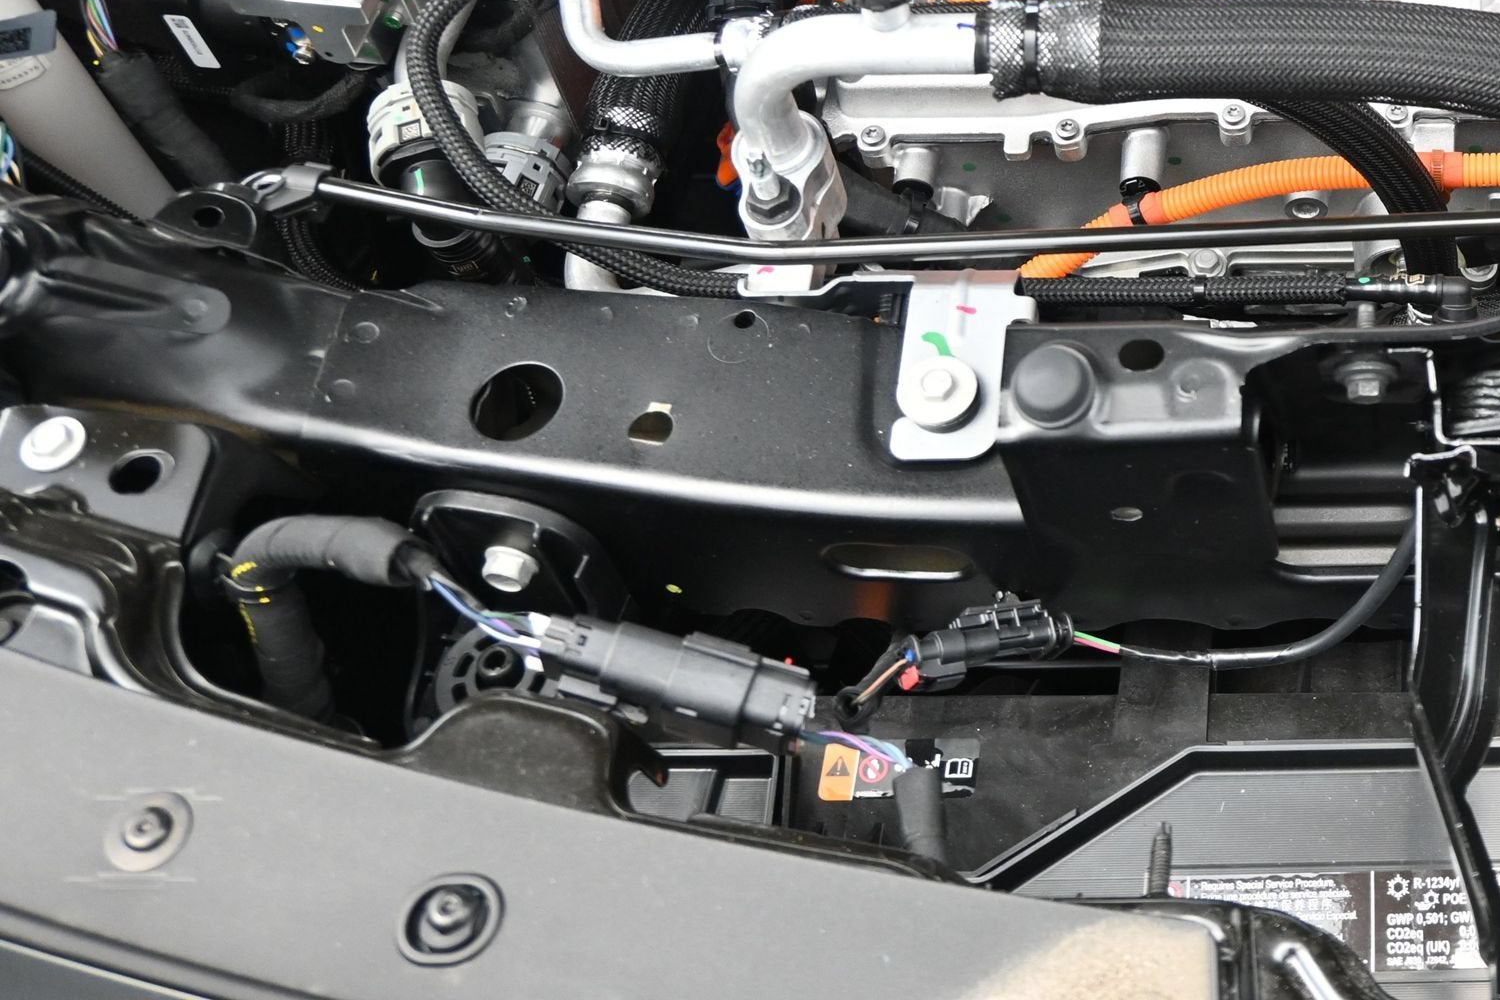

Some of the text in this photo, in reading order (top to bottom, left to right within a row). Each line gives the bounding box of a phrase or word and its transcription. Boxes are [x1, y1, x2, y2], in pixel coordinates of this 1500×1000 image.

[1201, 878, 1336, 892] Requires Special Service Procedure.
[1279, 890, 1290, 898] de
[1291, 890, 1318, 898] service
[1443, 893, 1468, 905] POE
[1386, 911, 1474, 926] GWP 0,501; GW
[1386, 928, 1424, 941] CO2eq
[1386, 942, 1424, 955] CO2eq
[1426, 941, 1451, 955] (UK)
